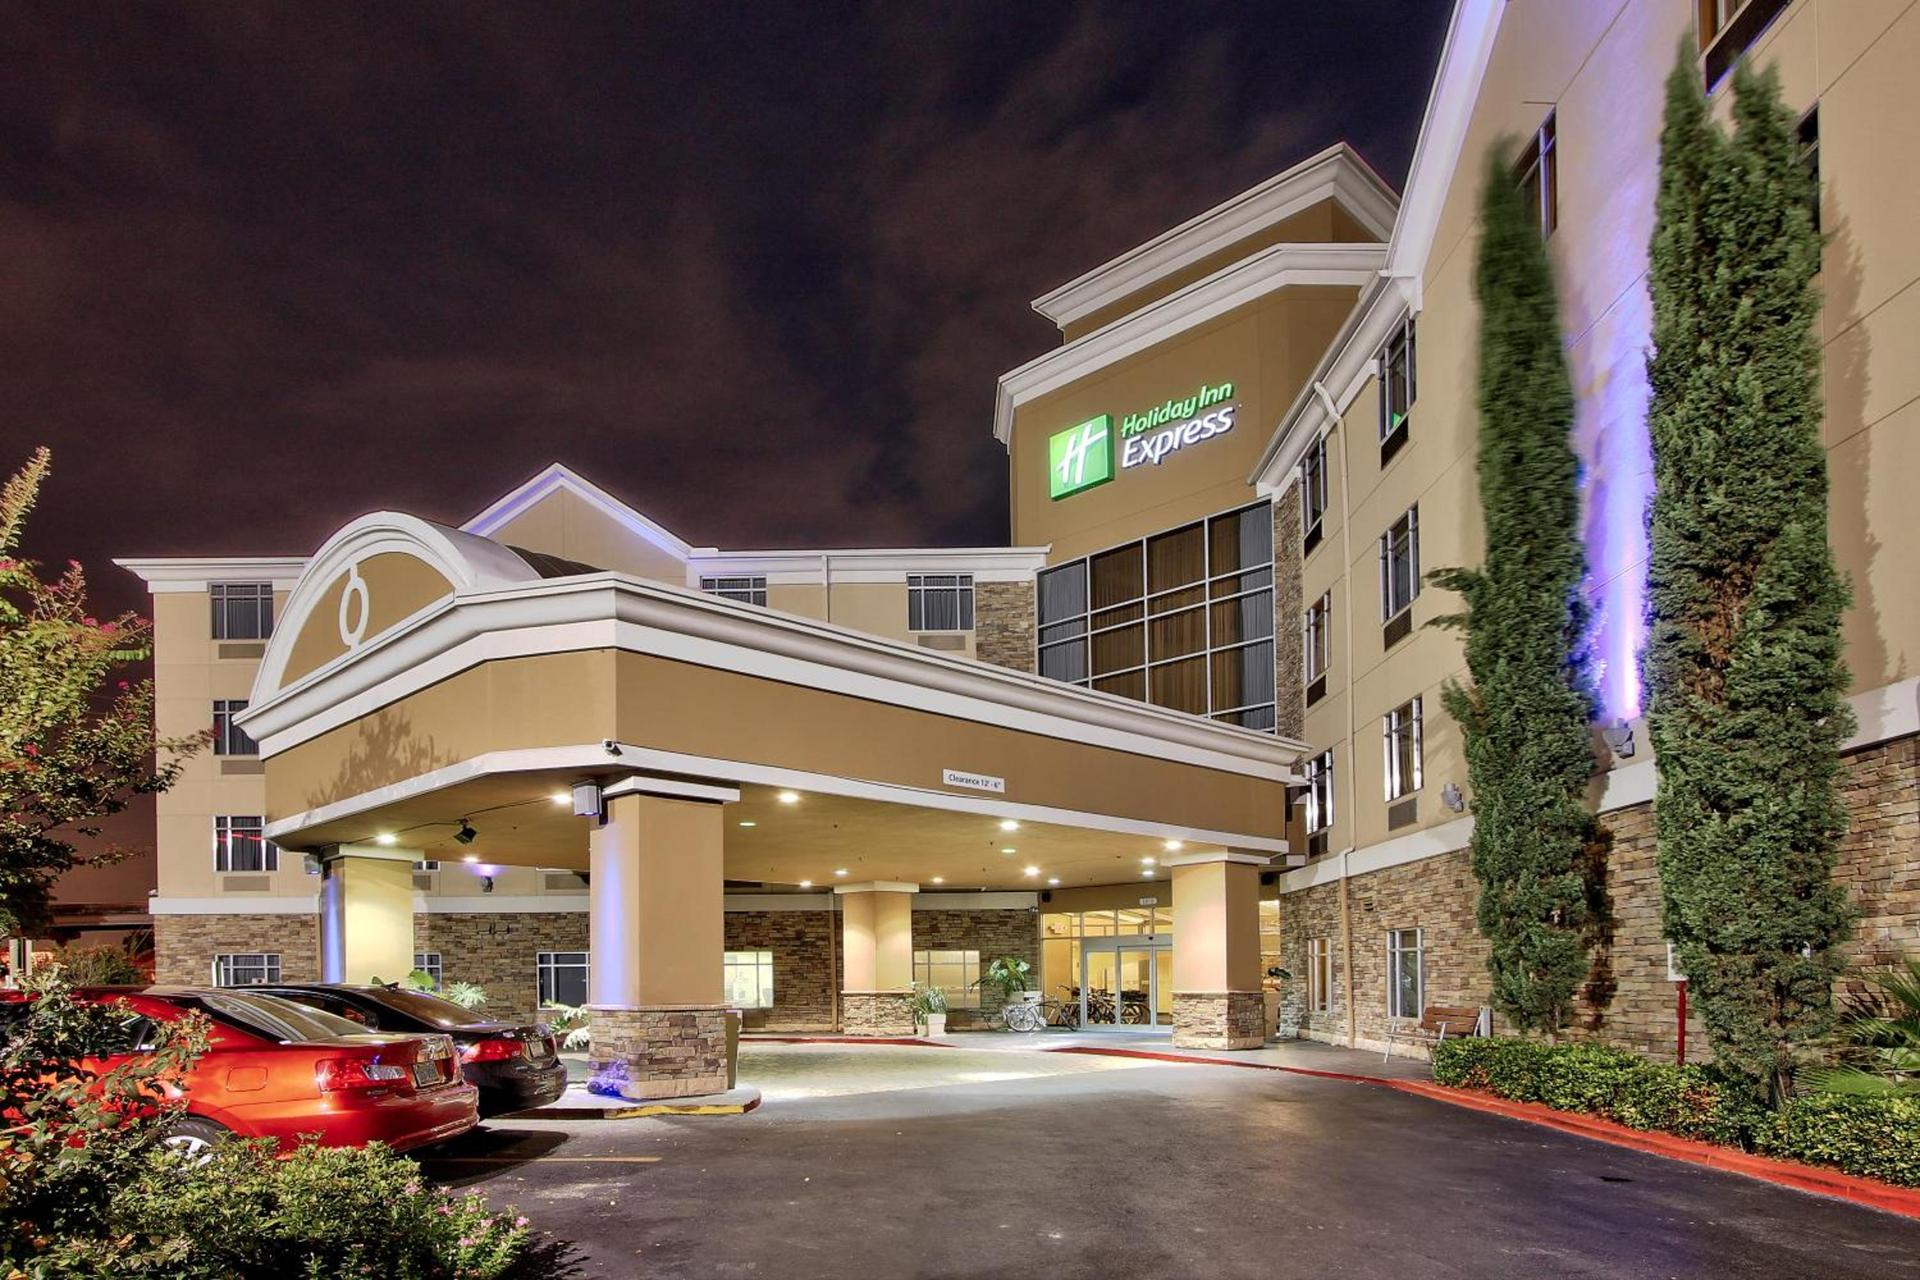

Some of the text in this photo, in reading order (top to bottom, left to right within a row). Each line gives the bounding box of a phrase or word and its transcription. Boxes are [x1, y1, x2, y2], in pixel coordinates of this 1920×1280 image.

[1121, 383, 1233, 438] Holiday Inn
[1122, 406, 1235, 469] Express
[948, 773, 980, 786] Clearance
